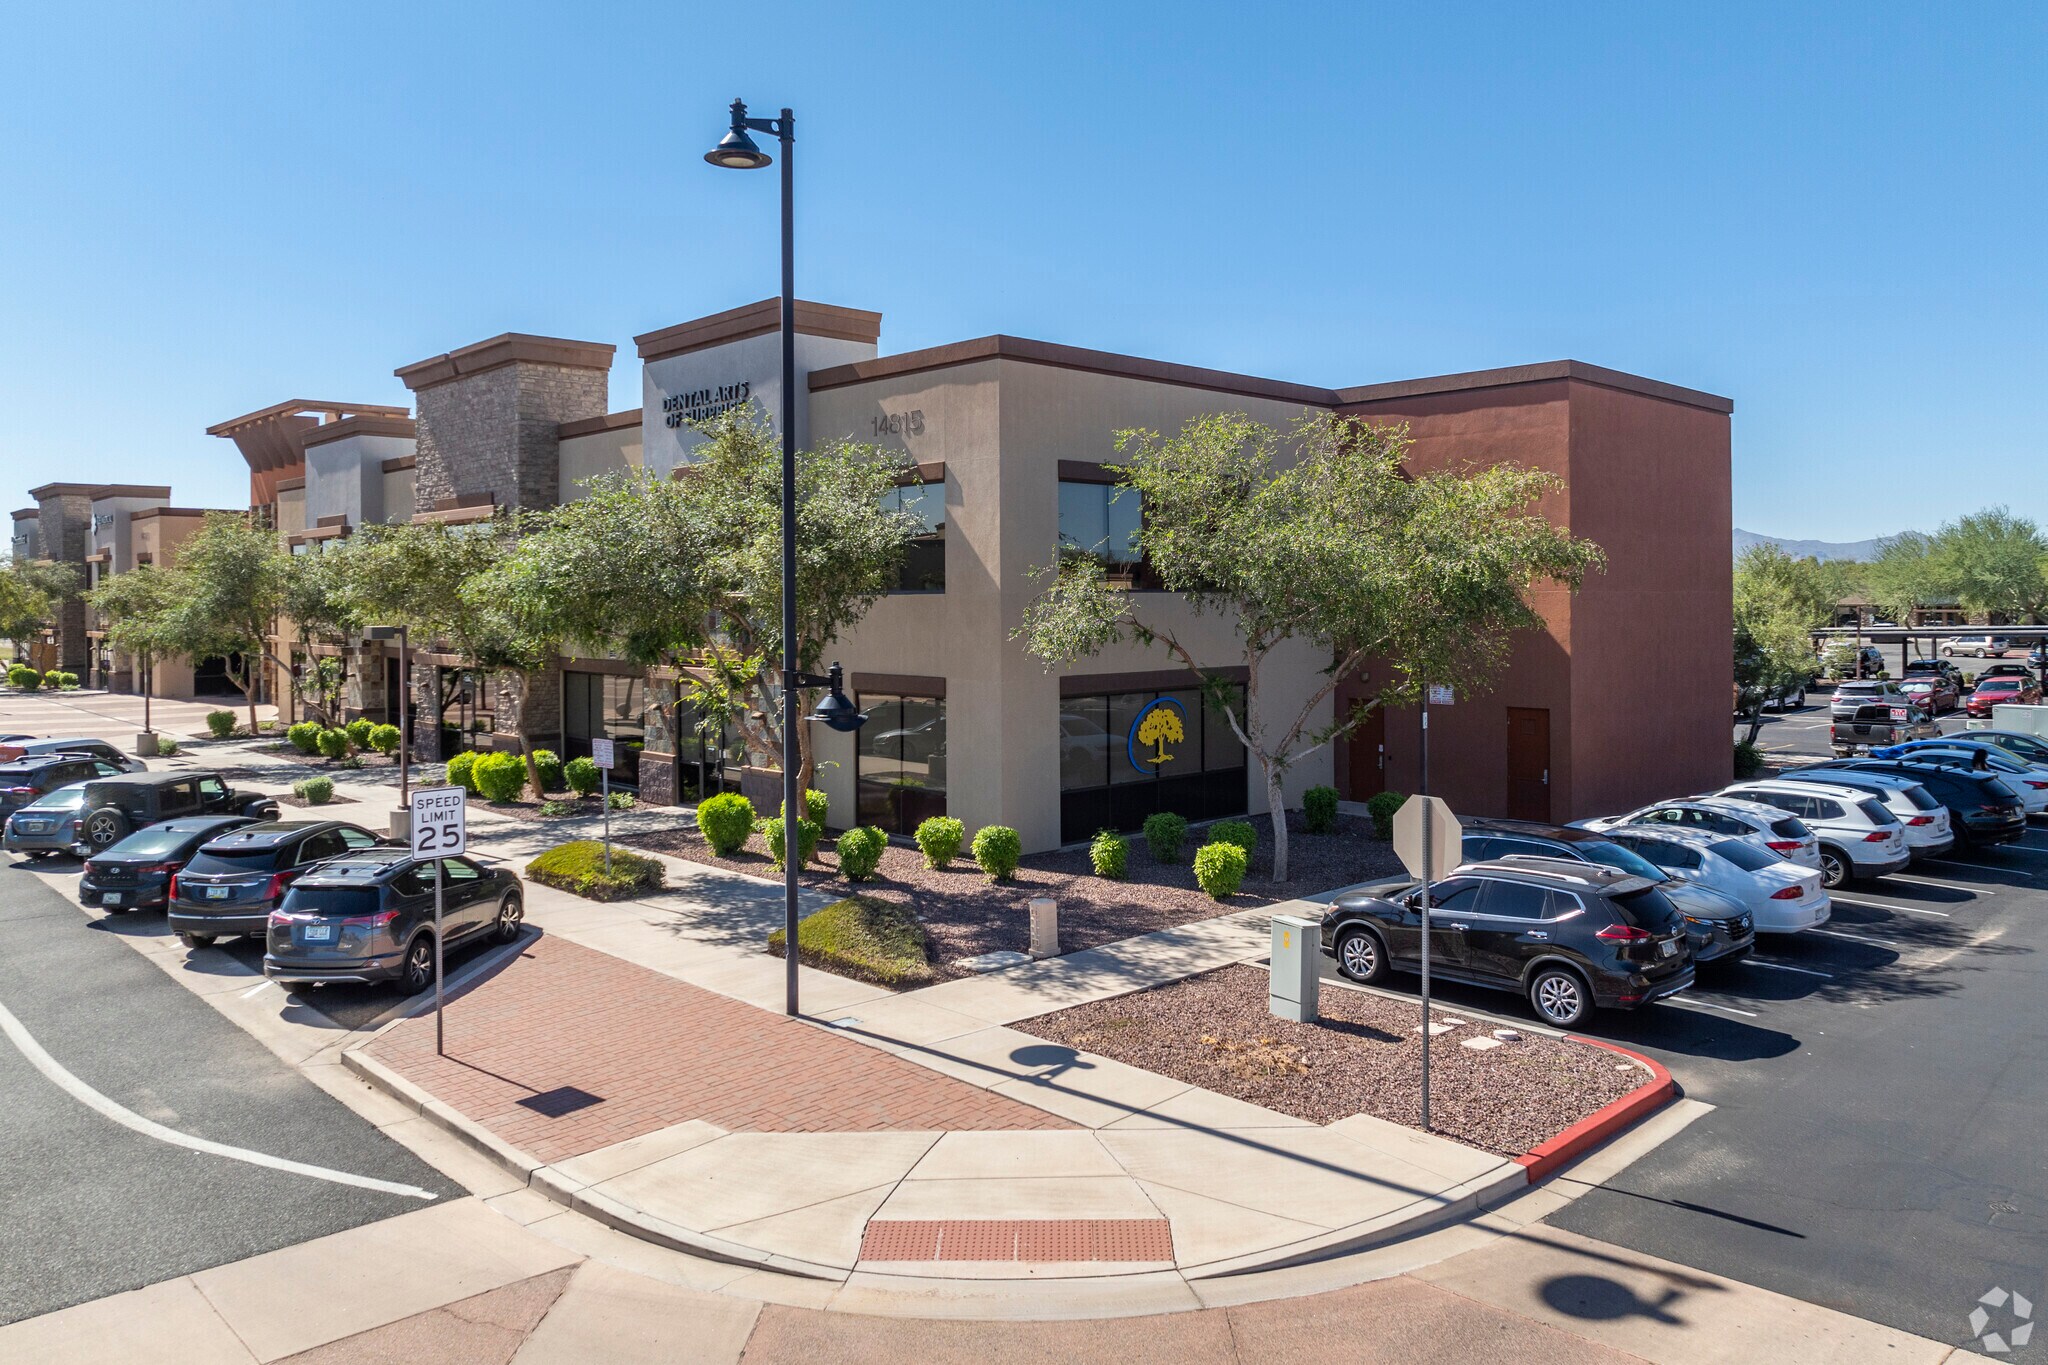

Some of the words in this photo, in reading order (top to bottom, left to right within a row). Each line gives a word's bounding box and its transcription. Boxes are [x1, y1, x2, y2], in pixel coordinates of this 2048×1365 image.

[663, 389, 711, 413] DENTAL
[714, 380, 750, 402] ARTS
[665, 411, 682, 429] OF
[871, 409, 923, 437] 14815
[417, 796, 460, 809] SPEED
[421, 810, 455, 823] LIMIT
[418, 824, 460, 851] 25
